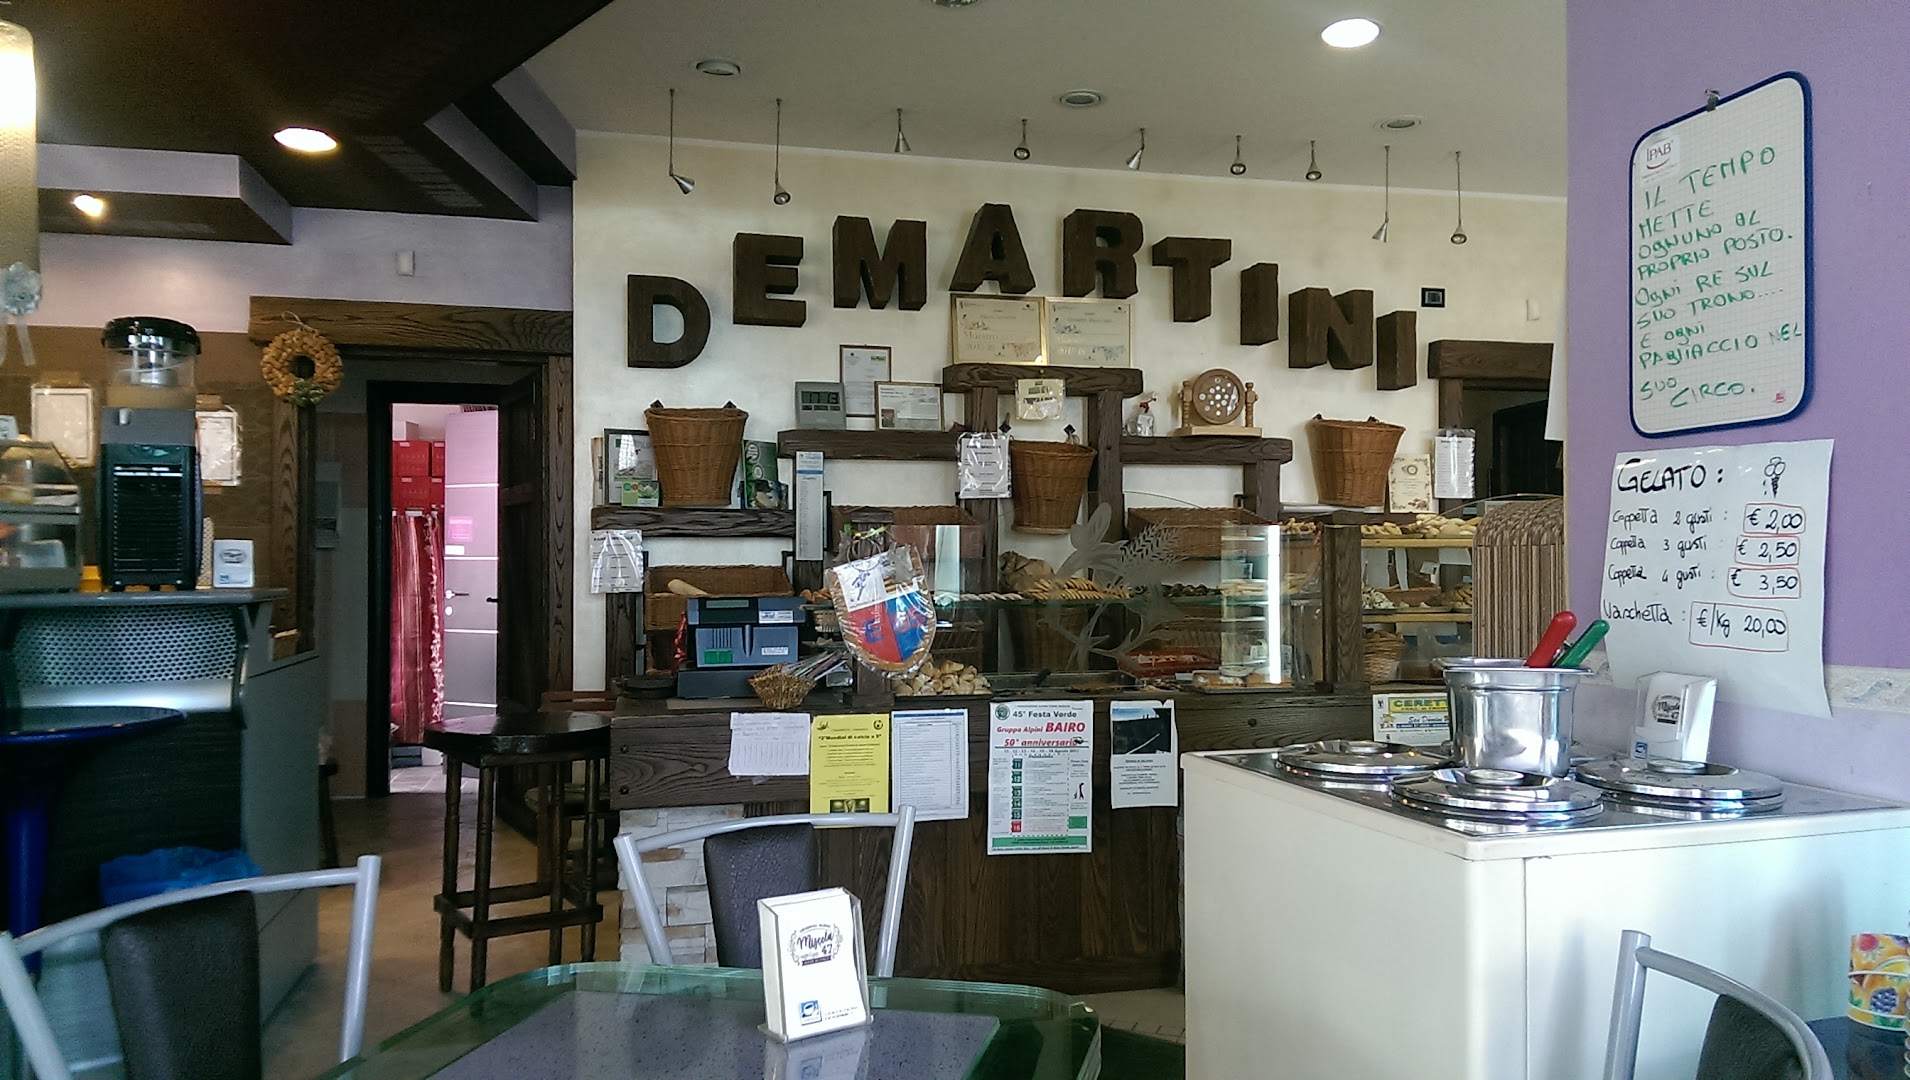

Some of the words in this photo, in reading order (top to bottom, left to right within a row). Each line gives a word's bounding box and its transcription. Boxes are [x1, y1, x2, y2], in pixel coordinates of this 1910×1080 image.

[1644, 185, 1666, 210] IL
[1679, 146, 1776, 194] TEMPO
[1639, 199, 1715, 239] METTE
[1735, 209, 1761, 228] AL
[1637, 248, 1711, 281] PROPRIO
[1695, 269, 1724, 294] RE
[1735, 260, 1774, 285] SUL
[627, 203, 1417, 390] DEMARTINI
[1640, 332, 1651, 350] E
[1769, 322, 1803, 346] NEL
[1686, 507, 1713, 534] gusti
[1765, 509, 1803, 534] 2,00
[1677, 535, 1708, 559] gusti
[1757, 541, 1798, 563] 2,50
[1676, 564, 1702, 590] gusti
[1758, 575, 1799, 595] 3,50
[997, 726, 1022, 734] Gruppo
[1023, 726, 1043, 734] Alpini
[1045, 722, 1086, 733] BAIRO
[1021, 738, 1077, 747] anniversario
[821, 944, 832, 955] 47
